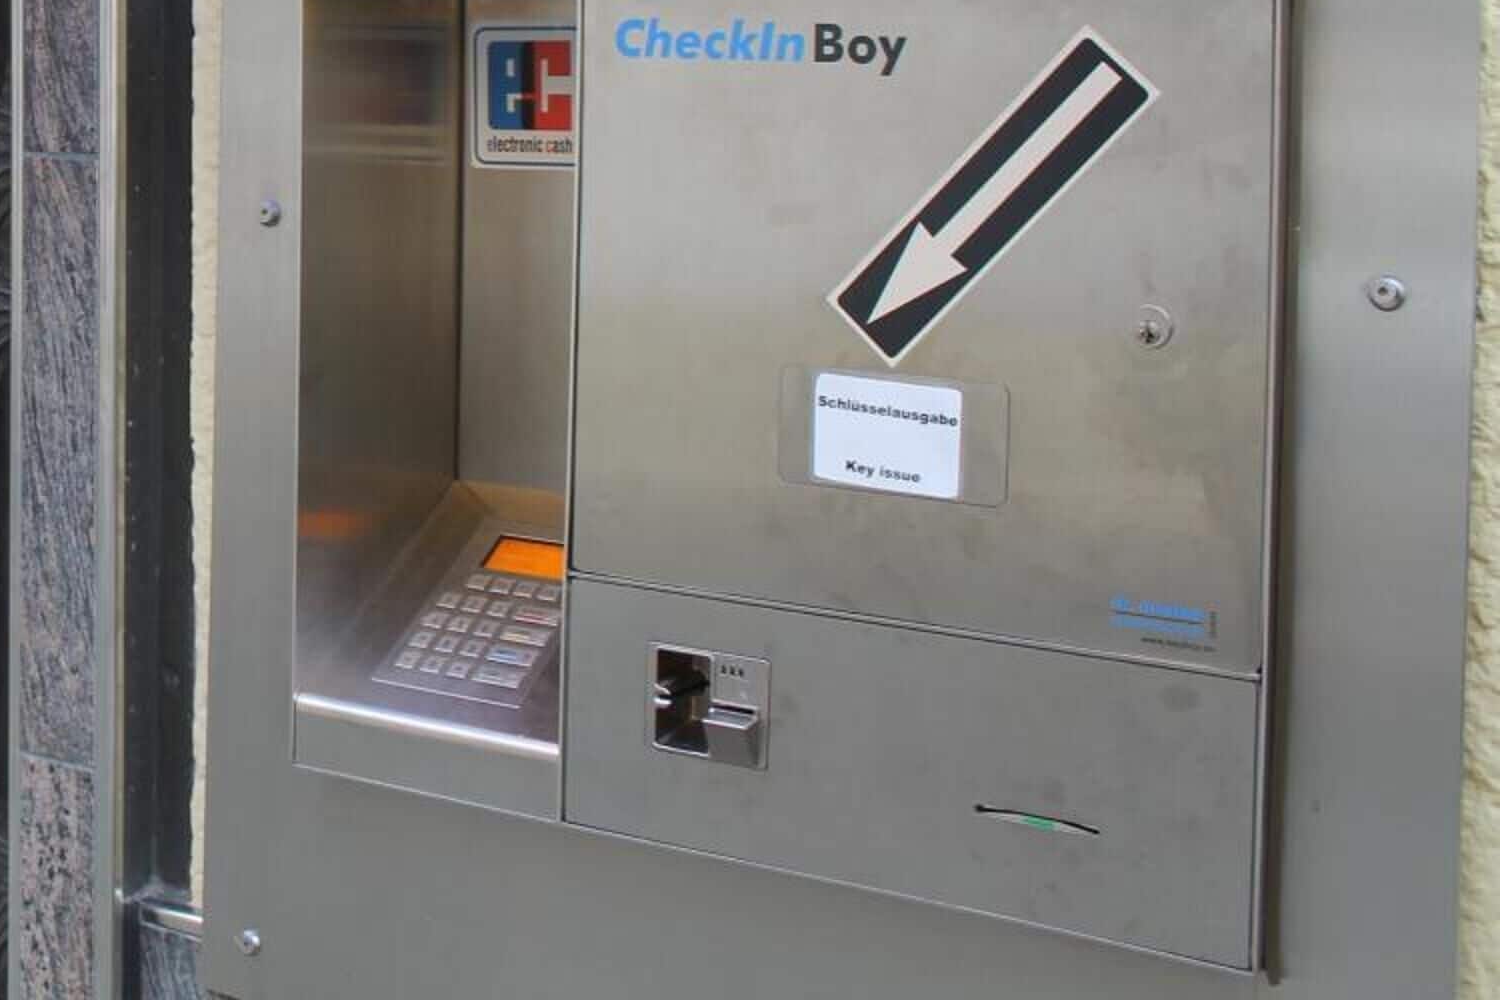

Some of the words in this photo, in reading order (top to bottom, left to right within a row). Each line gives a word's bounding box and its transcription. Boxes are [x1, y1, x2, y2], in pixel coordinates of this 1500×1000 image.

[614, 16, 805, 62] CheckIn
[812, 22, 908, 76] Boy
[487, 136, 543, 153] electronic
[547, 136, 573, 153] cash
[817, 395, 958, 427] Schlüsselausgabe
[845, 461, 875, 477] Key
[879, 464, 921, 483] issue
